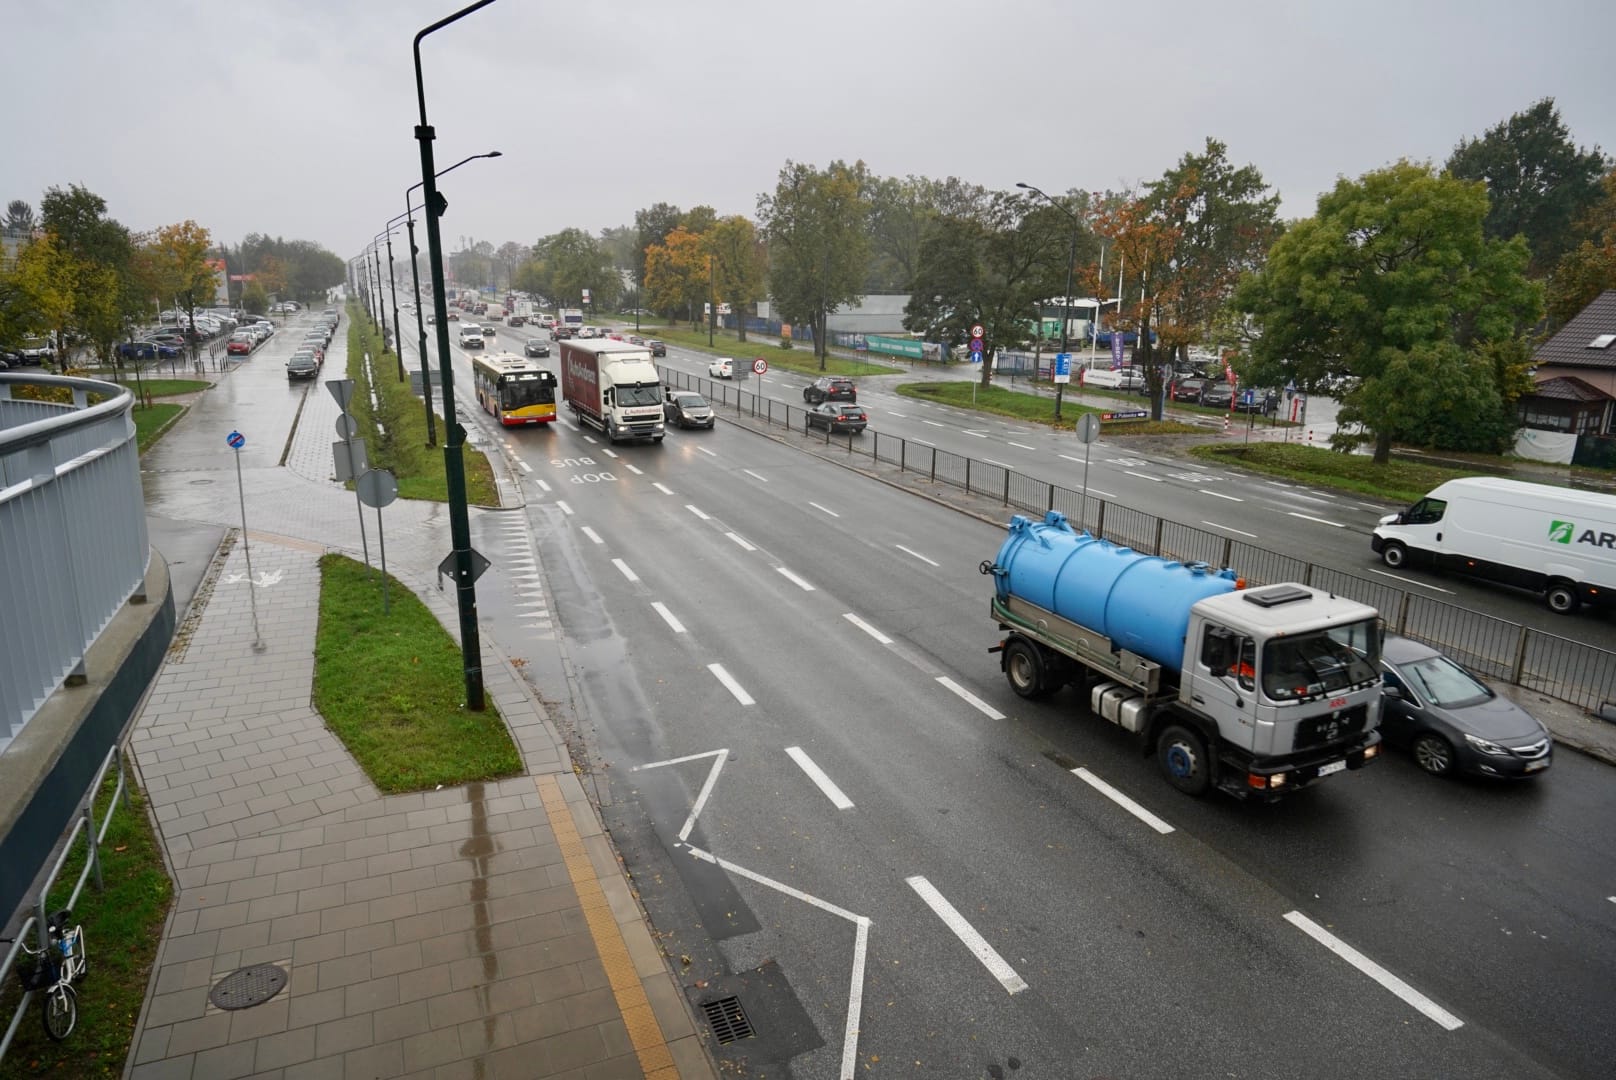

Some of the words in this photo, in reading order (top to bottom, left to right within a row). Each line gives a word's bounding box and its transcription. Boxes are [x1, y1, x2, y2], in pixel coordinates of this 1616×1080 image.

[974, 327, 983, 336] 60
[756, 362, 765, 371] 60
[550, 457, 597, 469] BUS
[1577, 528, 1616, 550] AR
